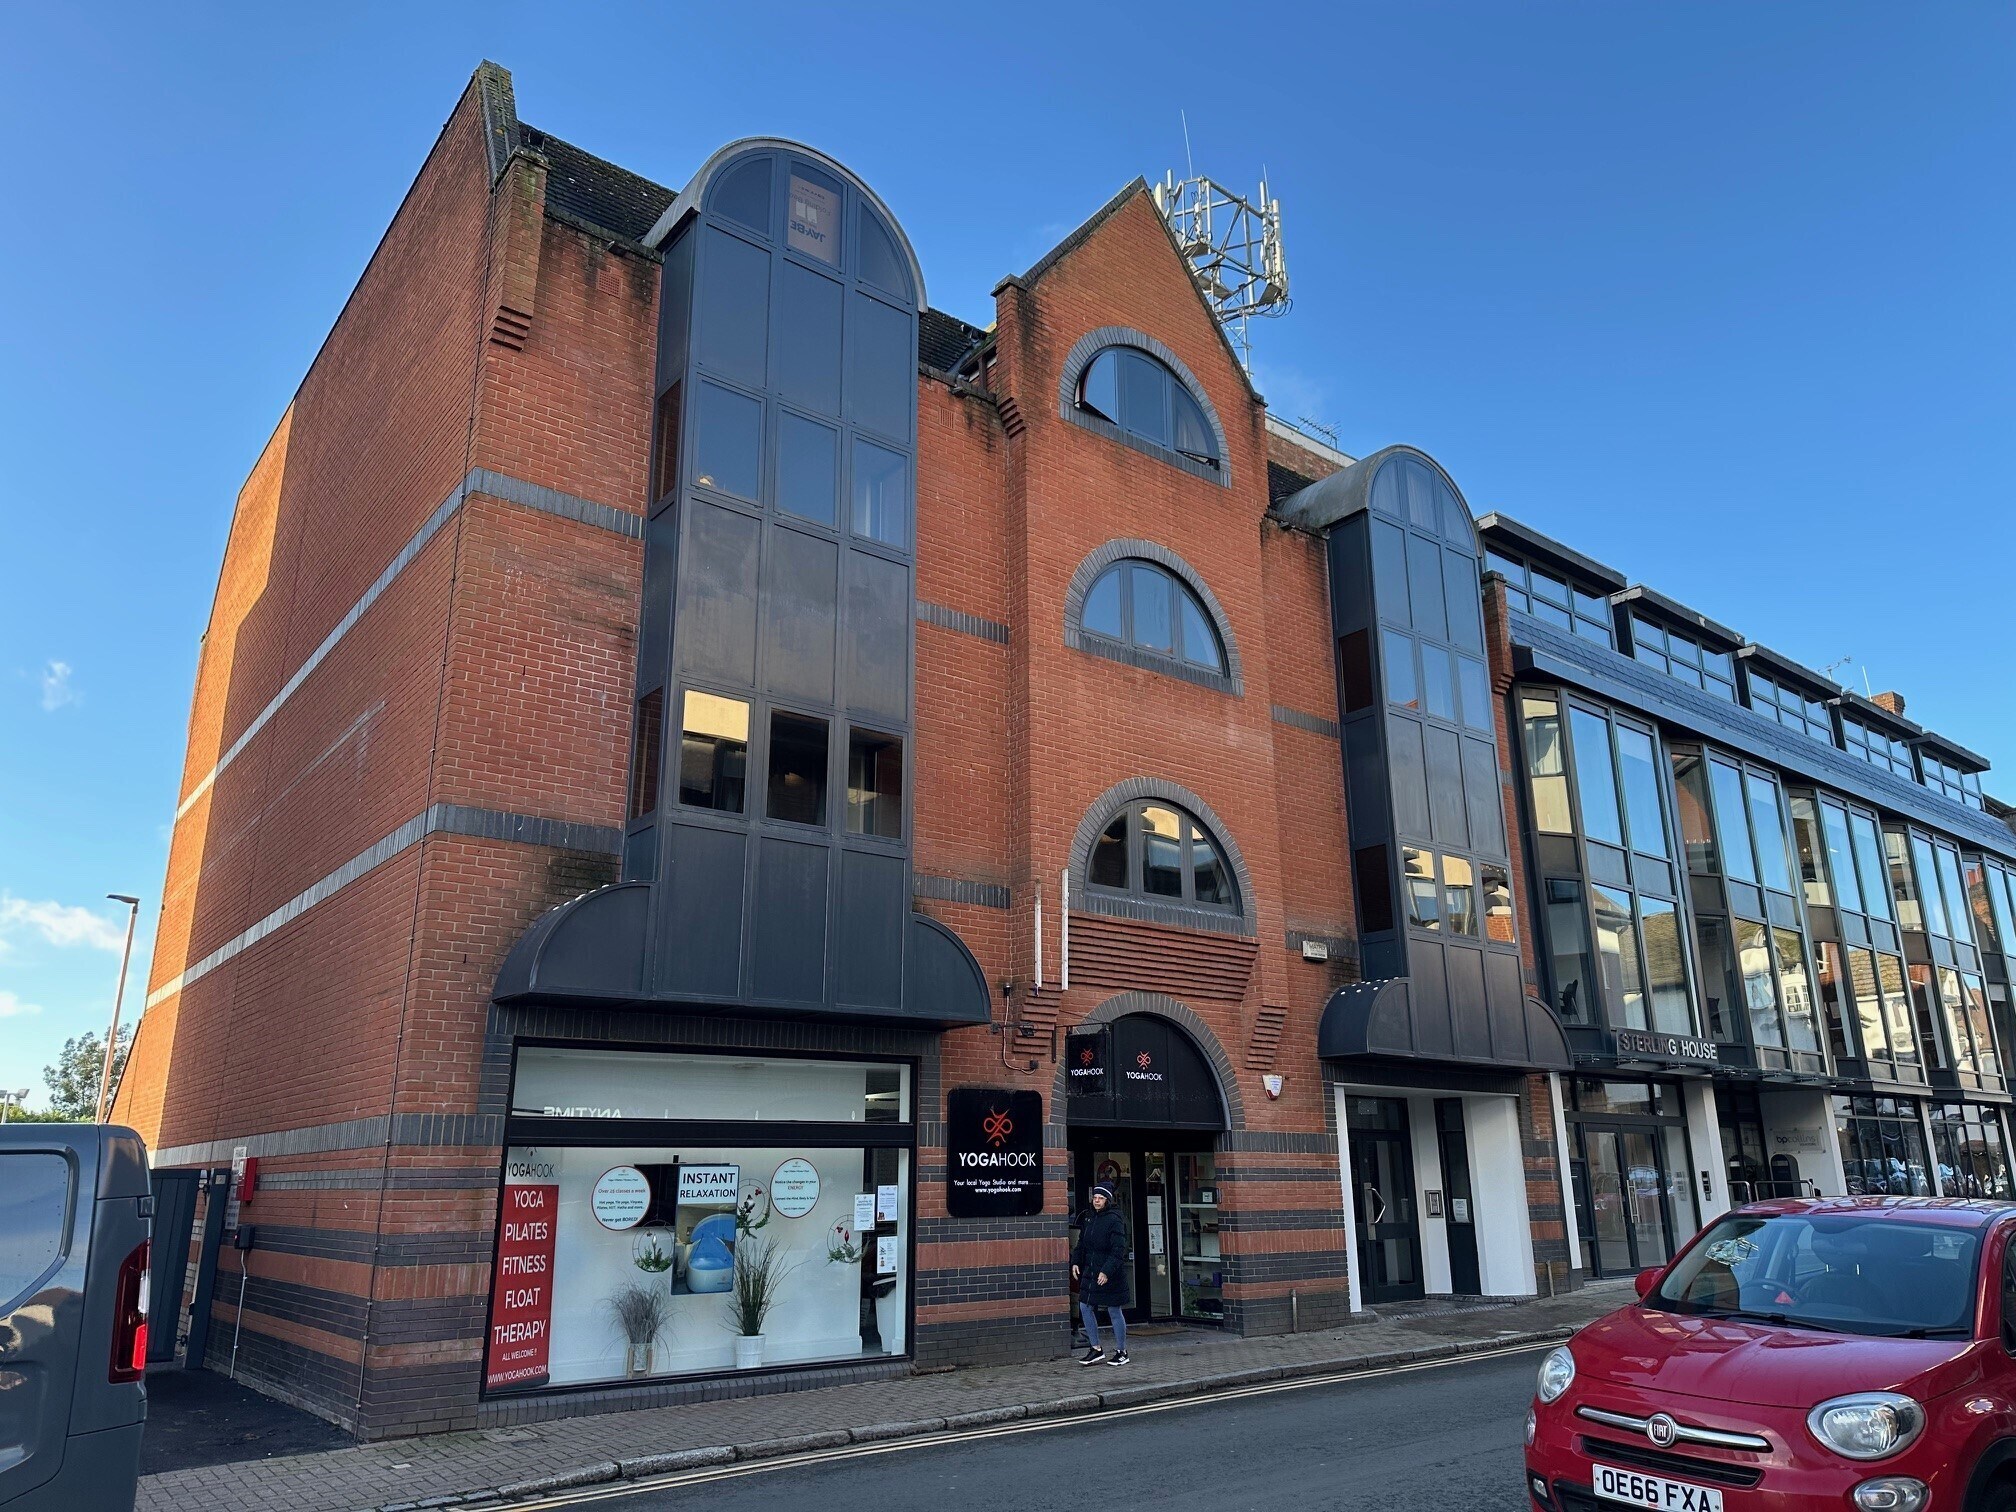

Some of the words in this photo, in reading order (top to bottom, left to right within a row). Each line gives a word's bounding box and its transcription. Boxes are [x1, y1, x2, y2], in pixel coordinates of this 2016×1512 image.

[1623, 1033, 1677, 1055] STERLING
[1681, 1040, 1717, 1060] HOUSE
[1070, 1067, 1104, 1076] YOGAHOOK
[1126, 1071, 1163, 1081] YOGAHOOK
[958, 1152, 1036, 1167] YOGAHOOK
[507, 1163, 555, 1178] YOGAHOOK
[682, 1173, 735, 1184] INSTANT
[979, 1179, 991, 1187] Yoga
[680, 1189, 736, 1198] RELAXATION
[974, 1186, 1022, 1194] www.yogahook.com
[514, 1190, 544, 1208] YOGA
[505, 1222, 548, 1242] PILATES
[502, 1254, 547, 1275] FITNESS
[505, 1287, 541, 1310] FLOAT
[494, 1319, 547, 1345] THERAPY
[502, 1352, 511, 1361] ALL
[511, 1348, 534, 1360] WELCOME
[487, 1364, 547, 1384] WWW.YOGAHOOK.COM
[1653, 1423, 1668, 1438] FIAT
[1602, 1469, 1659, 1504] OE66
[1665, 1482, 1712, 1512] FXA
